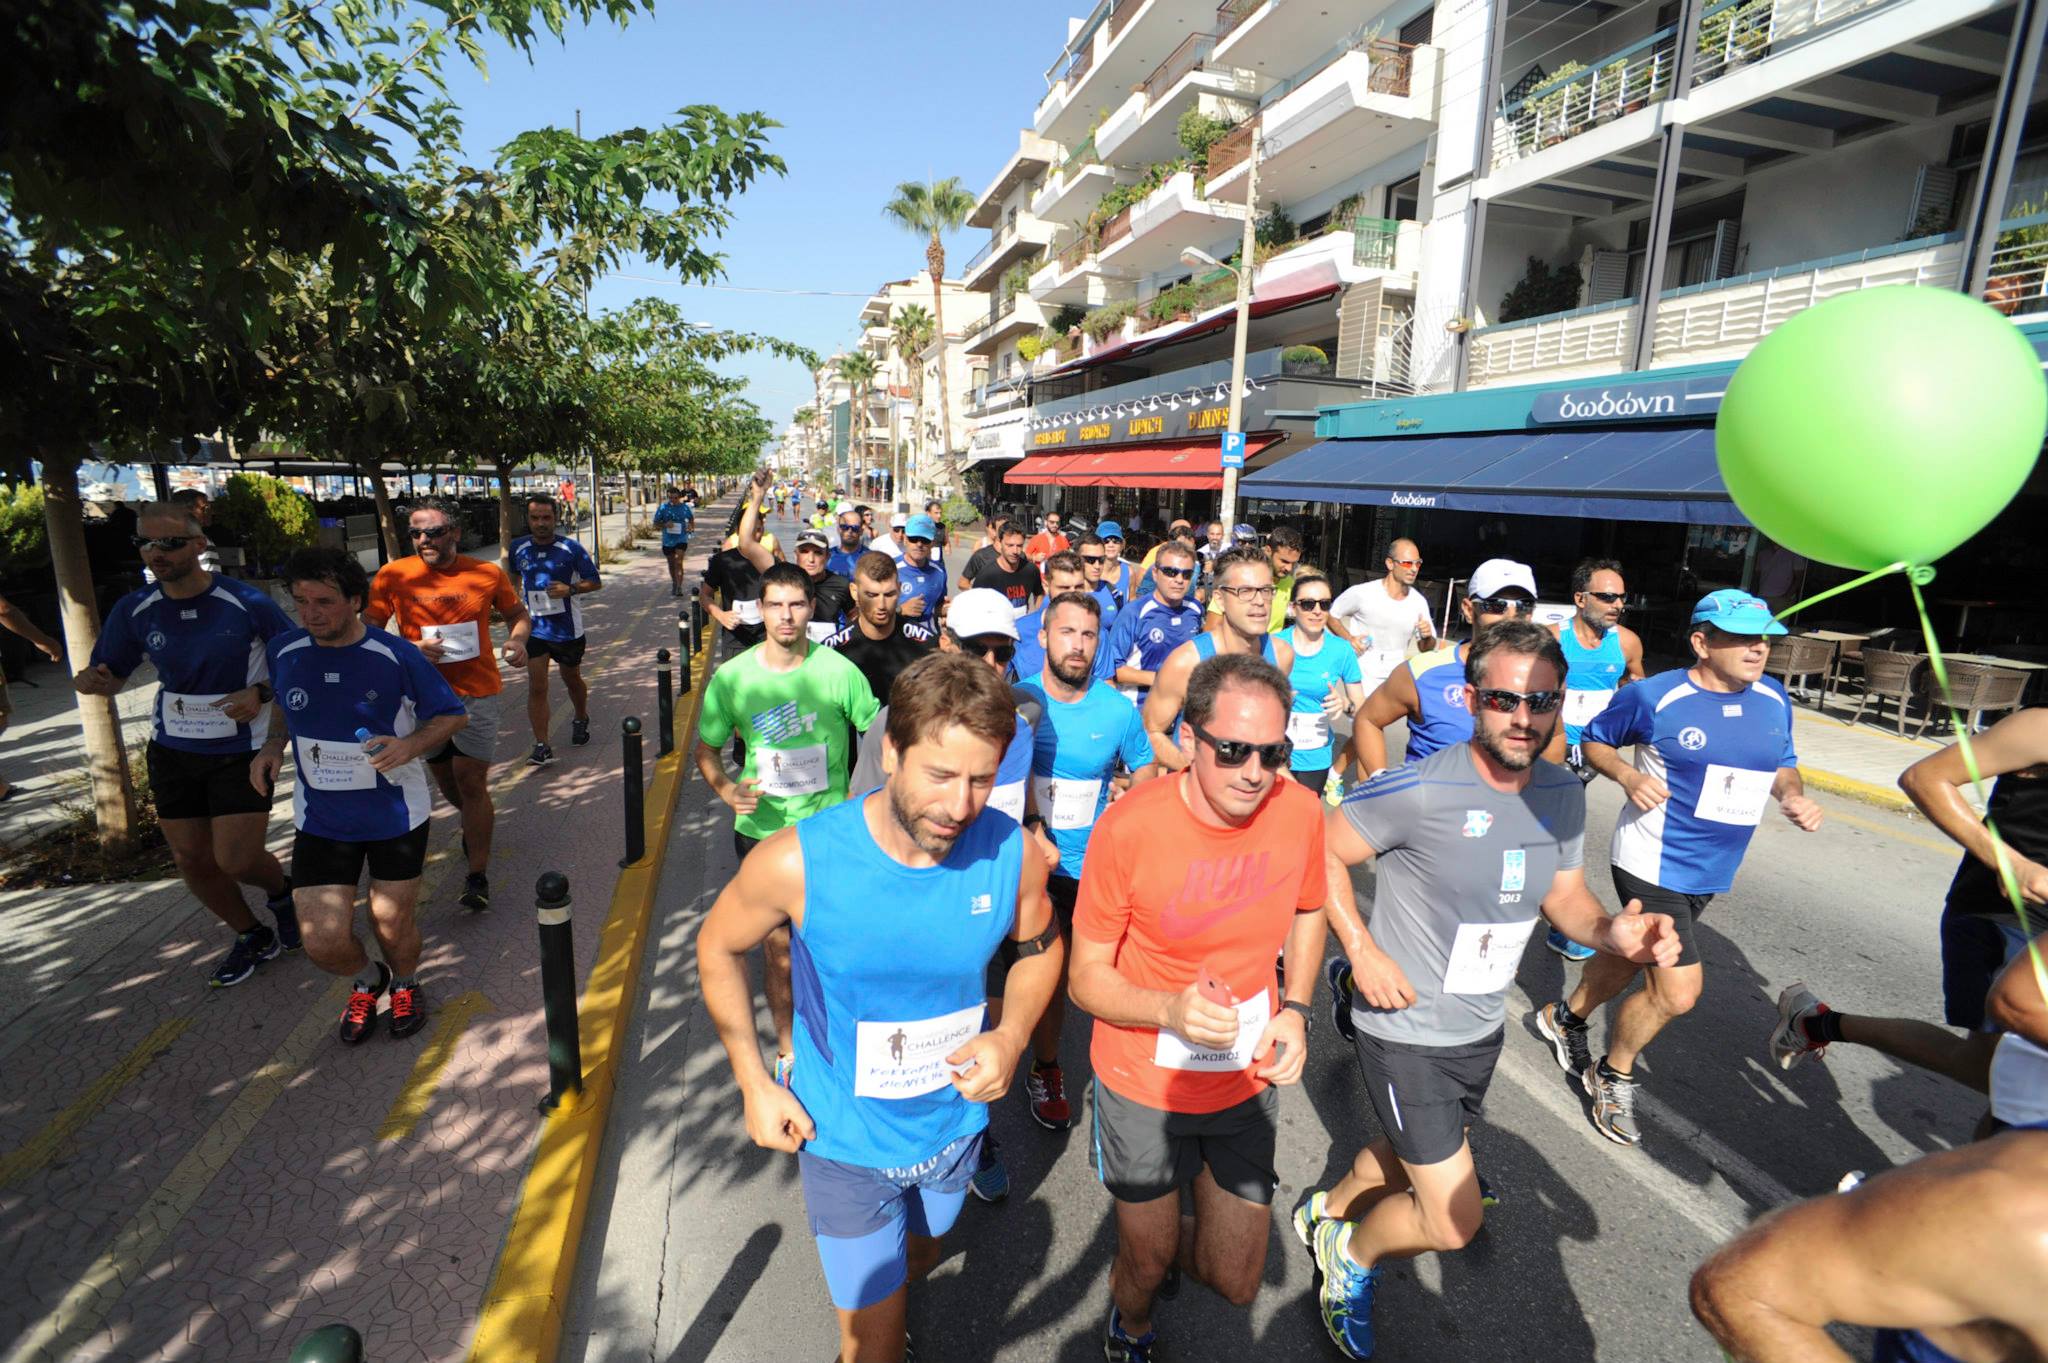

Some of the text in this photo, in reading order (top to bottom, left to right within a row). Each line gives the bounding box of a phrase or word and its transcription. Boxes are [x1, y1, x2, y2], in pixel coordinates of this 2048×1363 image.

[1560, 391, 1675, 418] δωδώνη
[1129, 416, 1163, 436] LUNCH
[1226, 434, 1240, 452] P
[1391, 491, 1436, 507] δωδώνη
[903, 623, 934, 641] QNT
[1182, 851, 1271, 903] RUN
[1498, 893, 1522, 904] 2013
[907, 1025, 972, 1052] CHALLENGE
[1190, 1051, 1241, 1062] ΙΑΚΩΒΟΣ
